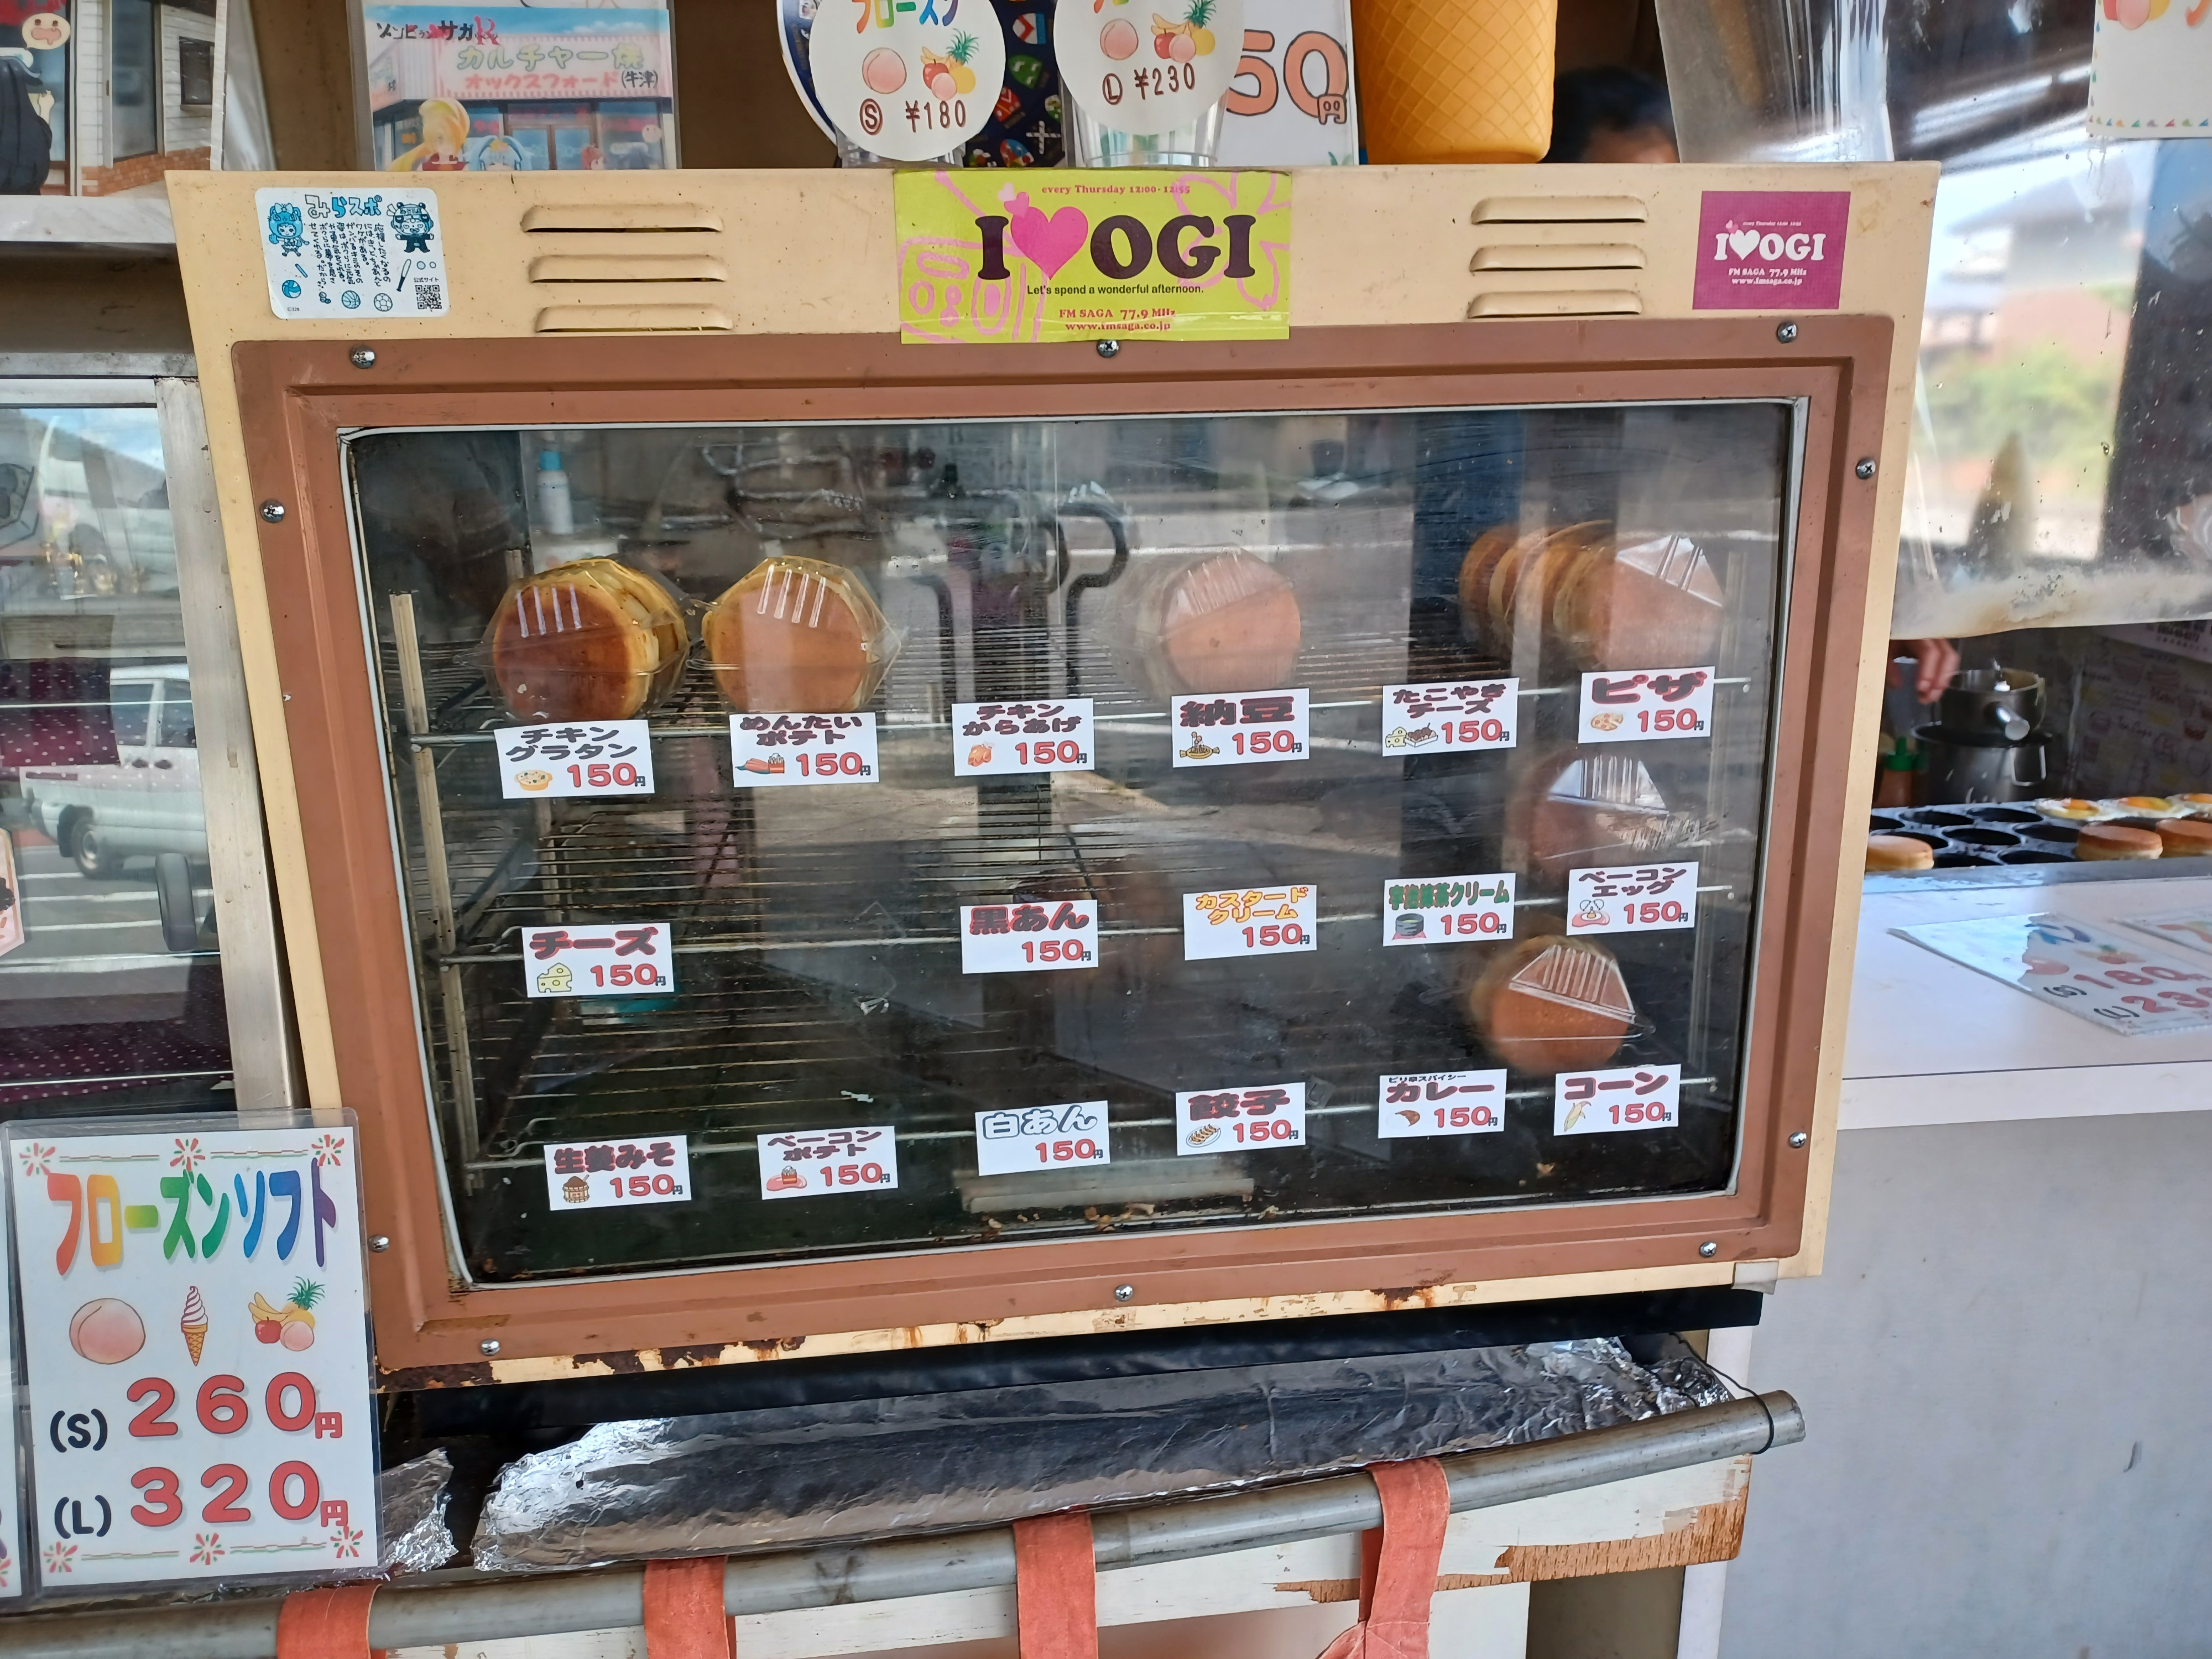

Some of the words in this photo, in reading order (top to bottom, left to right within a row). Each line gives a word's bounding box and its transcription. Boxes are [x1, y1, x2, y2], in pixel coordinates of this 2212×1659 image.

[1134, 62, 1196, 100] ¥230
[905, 100, 967, 133] ¥180
[1075, 185, 1125, 194] Thursday
[305, 194, 382, 218] みらスポ
[975, 215, 1010, 280] I
[1090, 214, 1256, 279] OGI
[1714, 233, 1729, 260] I
[1759, 233, 1827, 261] OGI
[1027, 285, 1052, 294] Let's
[1055, 284, 1086, 296] spend
[1098, 284, 1149, 294] wonderful
[1152, 284, 1204, 294] afternoon.
[1060, 309, 1076, 318] FM
[1079, 309, 1113, 318] SAGA
[1120, 309, 1148, 320] 77.9
[1393, 684, 1506, 704] たこやき
[1592, 671, 1708, 704] ピザ
[977, 704, 1064, 720] チキン
[1180, 696, 1295, 727] 納豆
[1407, 699, 1493, 718] チーズ
[1637, 708, 1704, 732] 150円
[740, 715, 862, 731] めんたい
[962, 716, 1082, 736] からあげ
[1441, 719, 1510, 744] 150円
[520, 727, 619, 744] チキン
[757, 729, 845, 746] ポテト
[1232, 730, 1302, 755] 150円
[505, 743, 638, 762] グラタン
[796, 752, 871, 776] 150円
[1015, 740, 1087, 765] 150円
[567, 762, 646, 787] 150円
[1579, 867, 1687, 883] ベーコン
[1195, 886, 1308, 910] カスタード
[1592, 879, 1674, 897] エッグ
[969, 902, 1089, 935] 黒あん
[1207, 904, 1298, 925] クリーム
[1441, 912, 1507, 935] 150円
[1624, 901, 1688, 924] 150円
[529, 926, 659, 960] チーズ
[1242, 924, 1310, 948] 150円
[1021, 939, 1091, 963] 150円
[590, 963, 666, 987] 150円
[1386, 1082, 1495, 1103] カレー
[1564, 1072, 1669, 1100] コーン
[982, 1104, 1098, 1140] 白あん
[1434, 1106, 1498, 1128] 150円
[1609, 1102, 1672, 1125] 150円
[768, 1130, 882, 1146] ベーコン
[1233, 1119, 1298, 1143] 150円
[783, 1144, 867, 1161] ポテト
[1035, 1139, 1103, 1163] 150円
[610, 1174, 683, 1198] 150円
[820, 1162, 890, 1187] 150円
[44, 1156, 337, 1276] フローズンソフト
[50, 1408, 108, 1452] (S)
[126, 1371, 343, 1439] 260円
[54, 1494, 112, 1540] (L)
[130, 1460, 349, 1529] 320円
